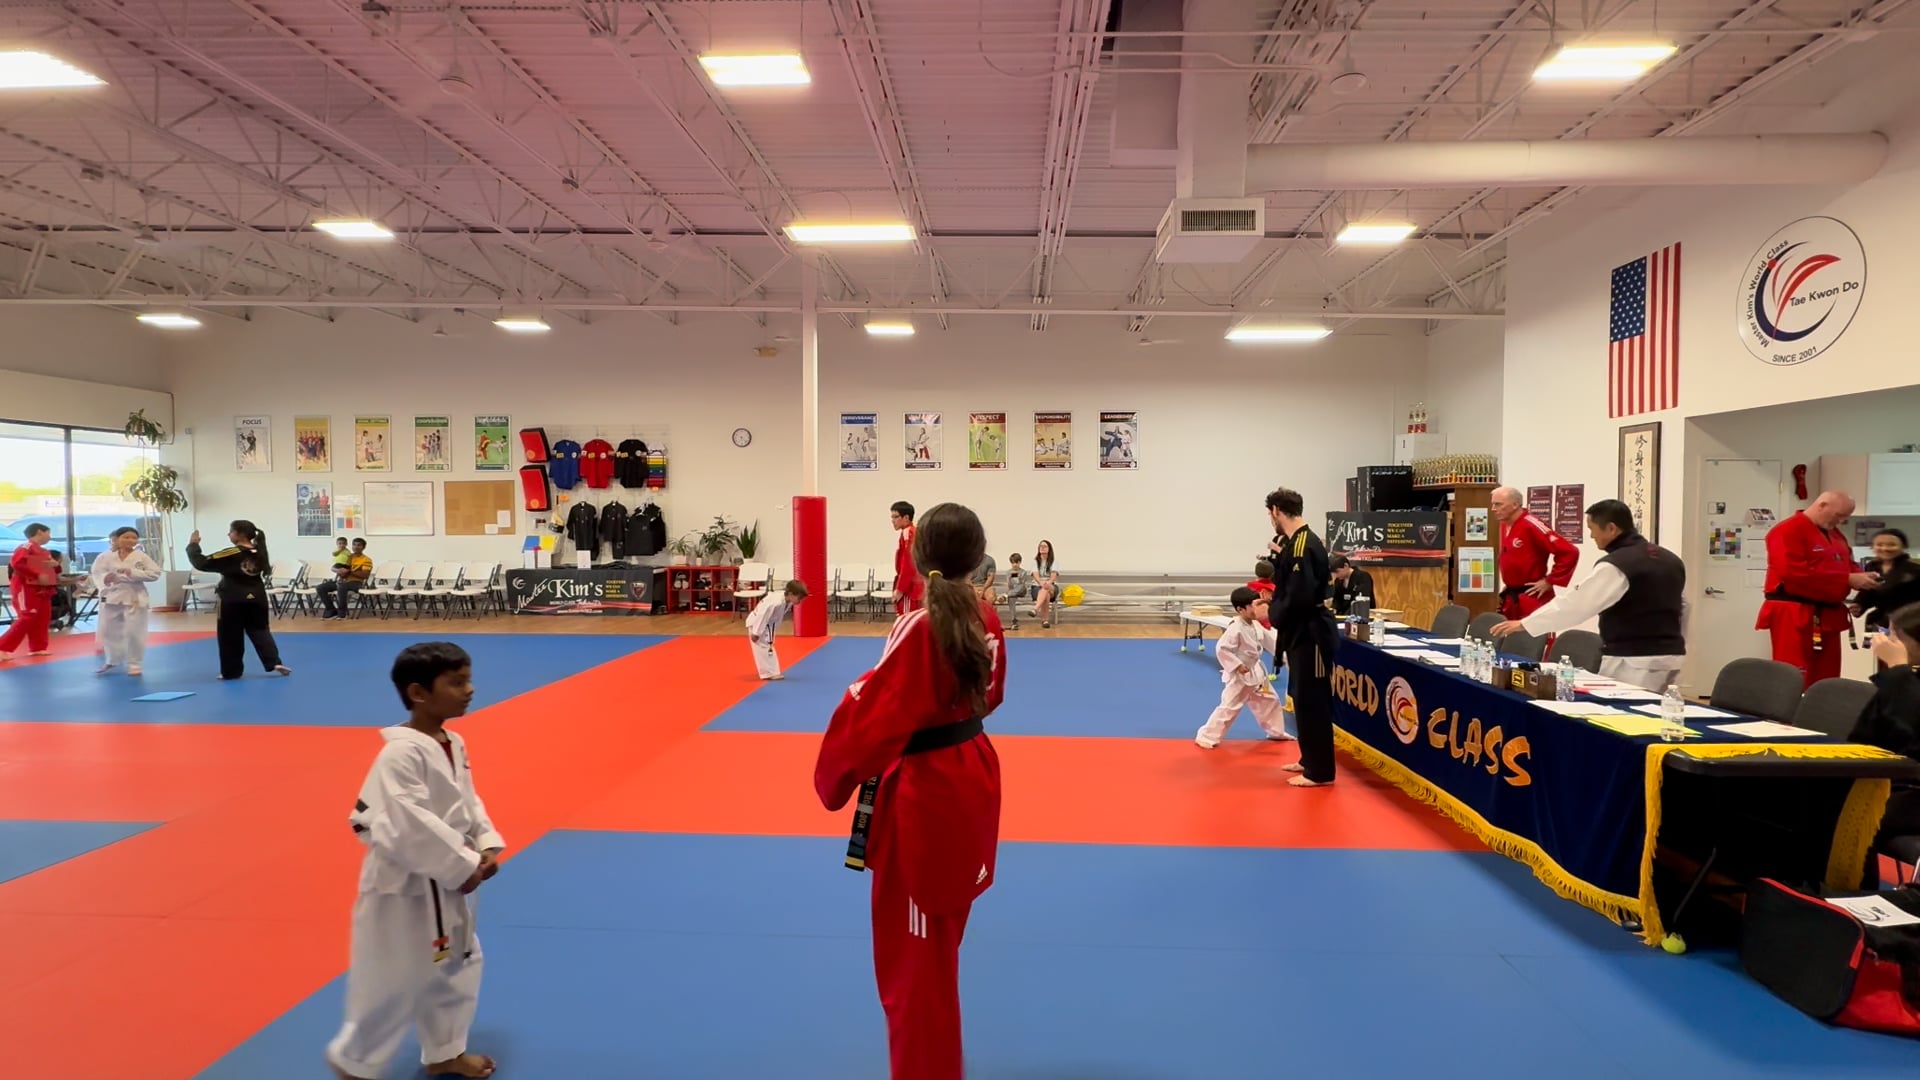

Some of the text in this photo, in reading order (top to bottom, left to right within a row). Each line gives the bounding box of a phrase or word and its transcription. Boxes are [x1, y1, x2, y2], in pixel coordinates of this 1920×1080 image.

[1747, 240, 1789, 348] Master Kim's World Class
[1789, 281, 1859, 307] Tae Kwon Do
[1772, 346, 1818, 363] SINCE 2001
[513, 578, 604, 614] Master Kim's
[1427, 707, 1532, 787] CLASS
